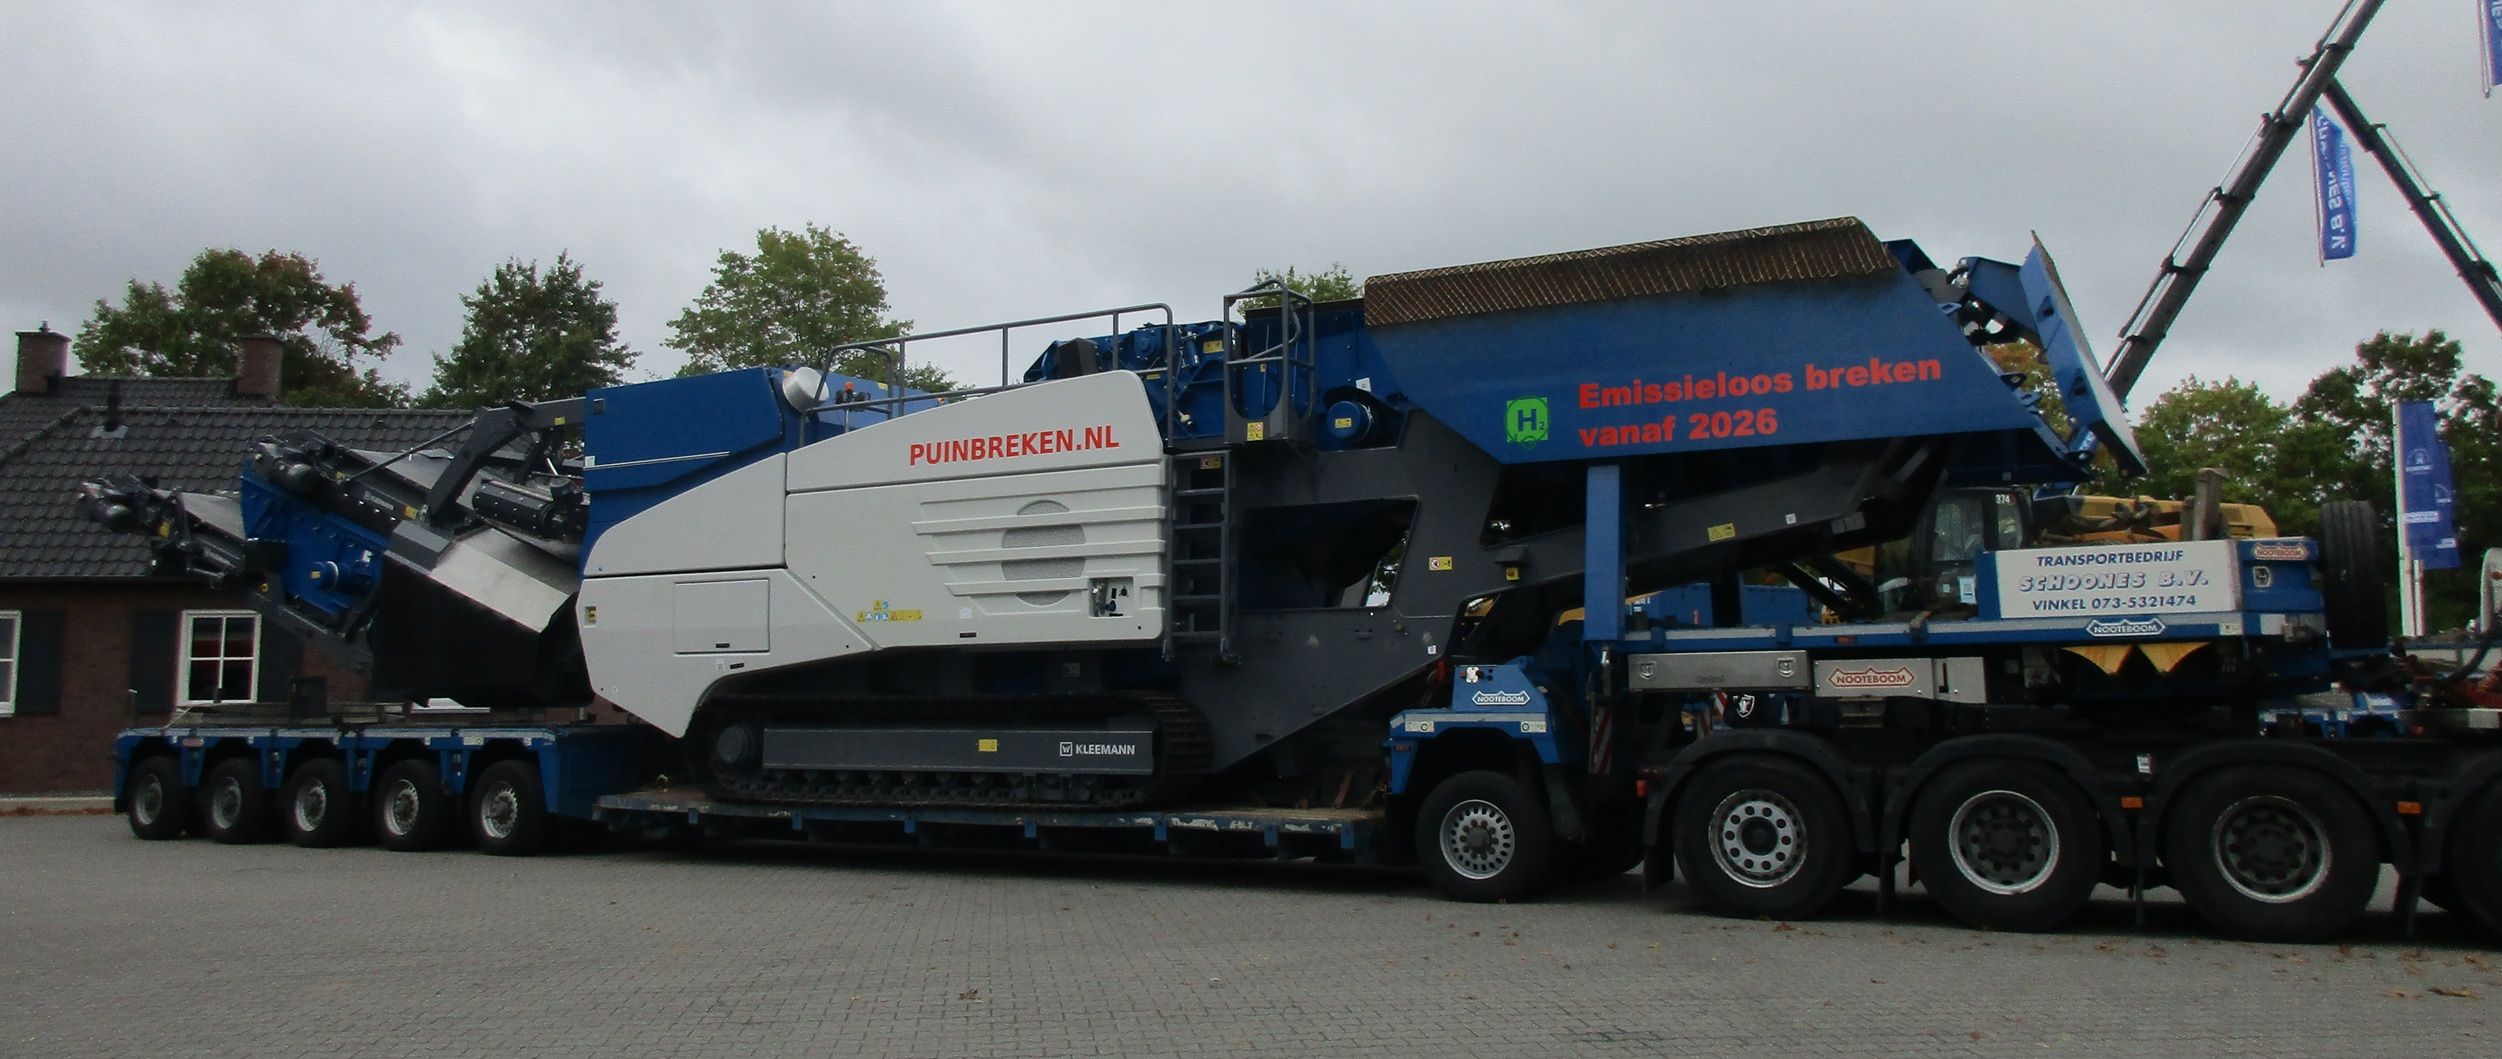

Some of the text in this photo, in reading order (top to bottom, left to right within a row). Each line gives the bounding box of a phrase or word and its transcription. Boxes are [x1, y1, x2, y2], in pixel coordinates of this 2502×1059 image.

[1578, 357, 1942, 409] Emissieloos breken
[1578, 407, 1779, 448] vanaf 2026
[910, 425, 1120, 466] PUINBREKEN.NL
[1995, 493, 2011, 505] 374
[2037, 550, 2184, 567] TRANSPORTBEDRIJF
[2019, 569, 2209, 592] SCHOONES B.V.
[2032, 594, 2197, 611] VINKEL 073-5321474
[2093, 624, 2159, 634] NOOTEBOOM
[1836, 675, 1907, 684] NOOTEBOOM
[1476, 695, 1525, 704] NOOTEBOOM
[1075, 743, 1136, 756] KLEEMANN
